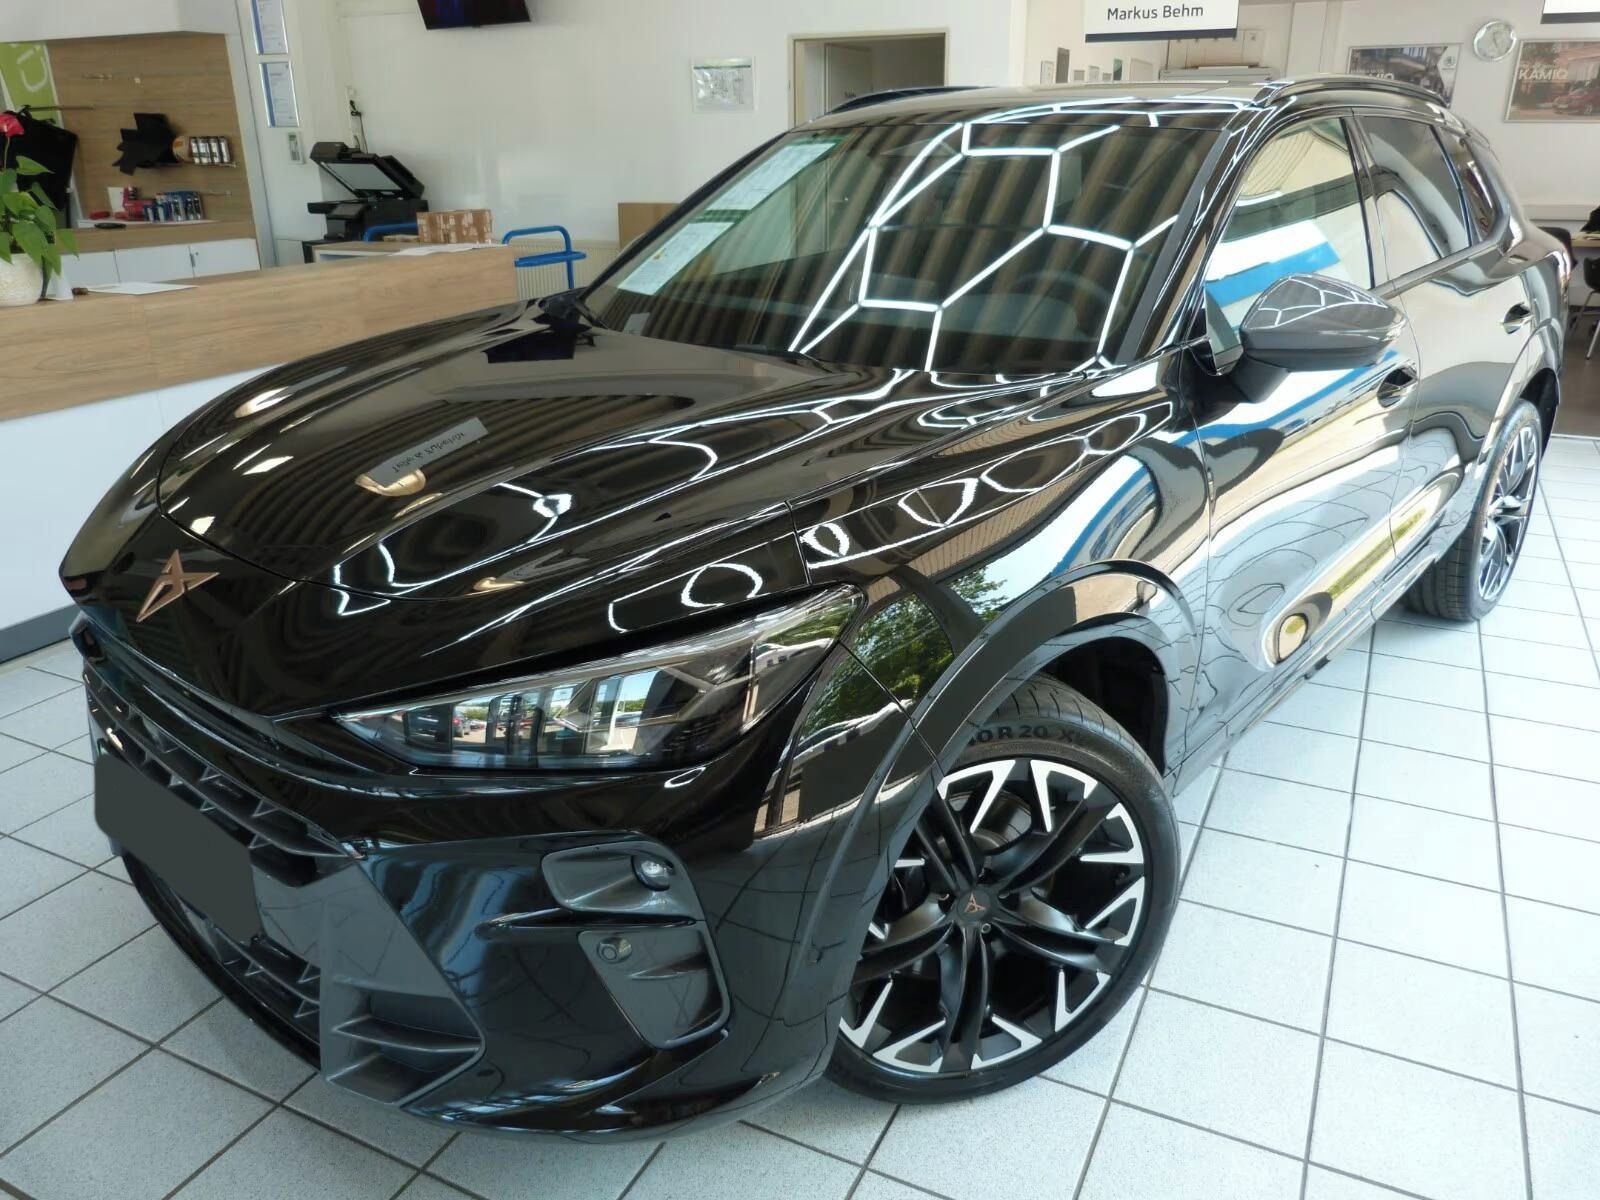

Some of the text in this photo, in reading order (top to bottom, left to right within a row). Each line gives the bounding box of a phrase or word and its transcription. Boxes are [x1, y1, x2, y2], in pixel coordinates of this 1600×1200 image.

[1107, 3, 1204, 20] Markus Behm
[1518, 69, 1568, 80] KAMIQ
